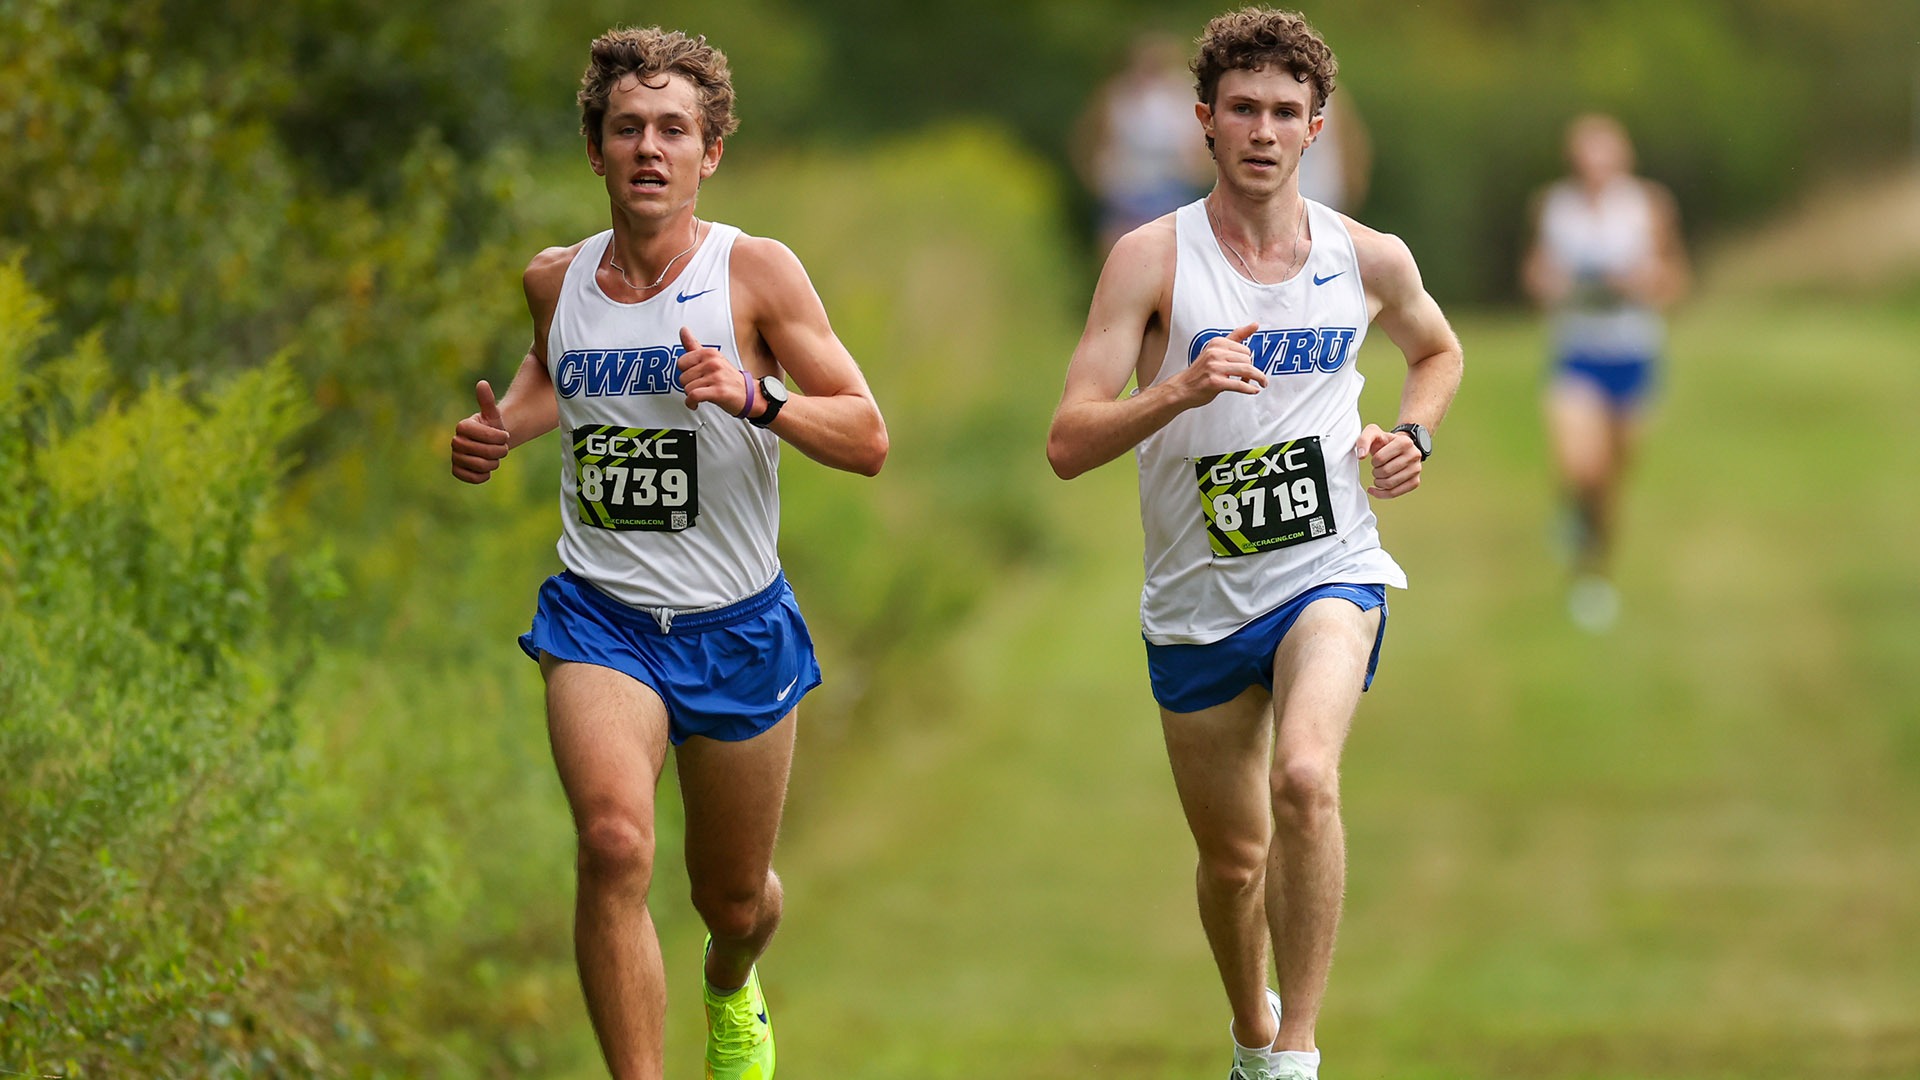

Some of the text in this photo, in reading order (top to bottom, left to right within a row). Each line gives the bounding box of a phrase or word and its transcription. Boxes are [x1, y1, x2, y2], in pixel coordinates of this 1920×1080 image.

[586, 433, 679, 459] GCXC
[1210, 447, 1308, 485] GCXC
[582, 464, 688, 507] 8739
[1212, 477, 1319, 532] 8719
